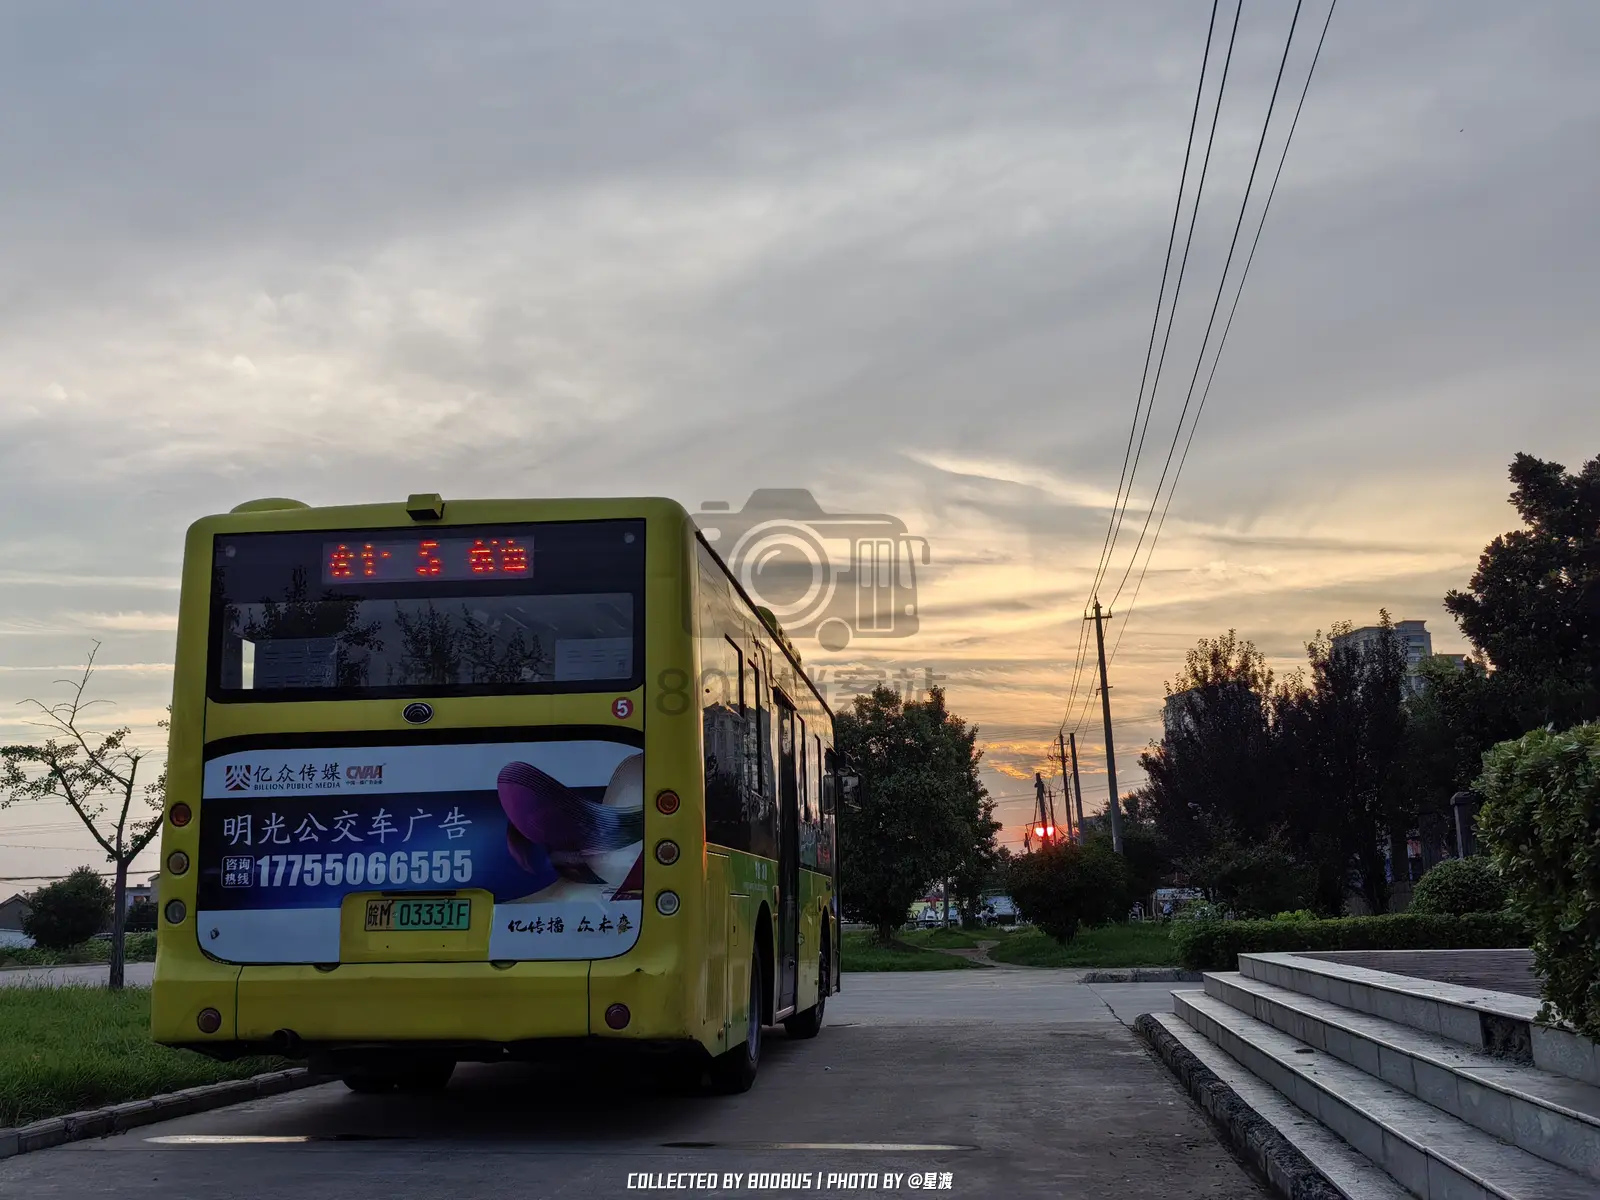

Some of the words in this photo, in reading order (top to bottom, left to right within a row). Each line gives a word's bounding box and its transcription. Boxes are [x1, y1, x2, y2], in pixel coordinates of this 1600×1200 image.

[616, 699, 629, 717] 5
[253, 762, 342, 783] 亿众传媒
[254, 783, 285, 791] BILLION
[286, 782, 313, 790] PUBLIC
[315, 781, 341, 789] MEDIA
[223, 807, 473, 846] 明光公交车广告
[226, 858, 250, 871] 咨询
[257, 850, 473, 887] 17755066555
[224, 872, 249, 886] 热线
[507, 916, 565, 934] 亿传播
